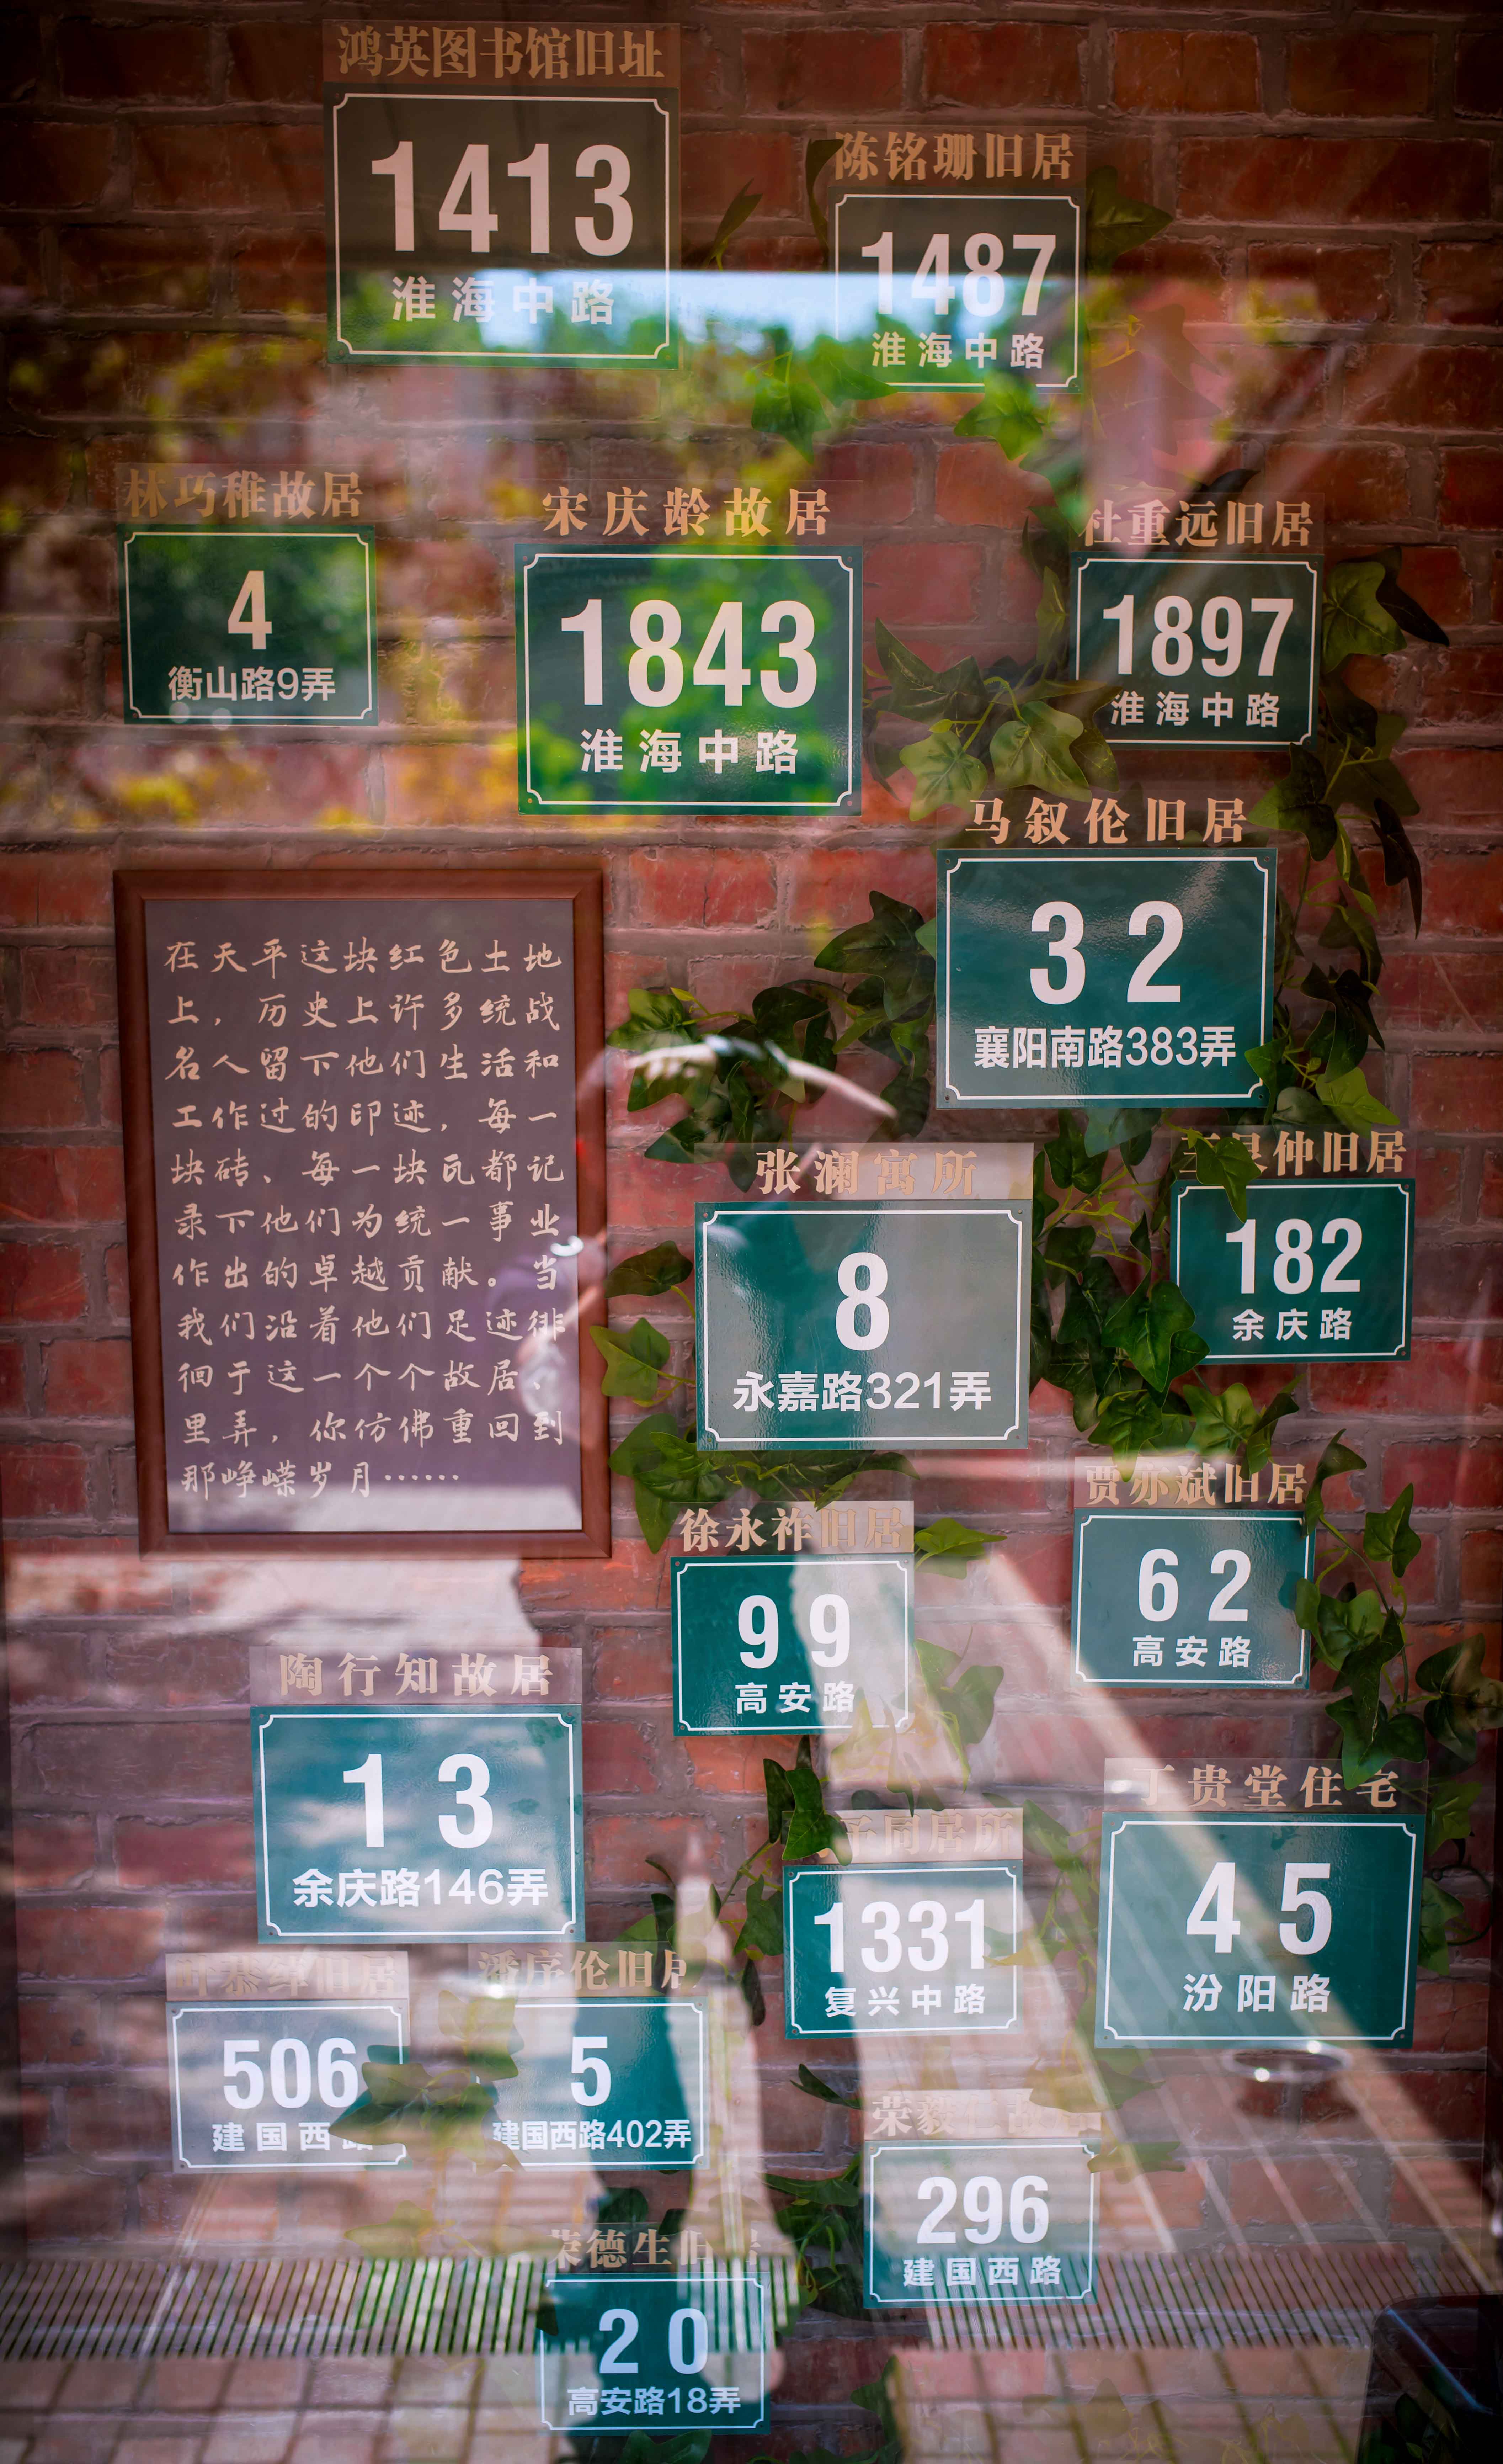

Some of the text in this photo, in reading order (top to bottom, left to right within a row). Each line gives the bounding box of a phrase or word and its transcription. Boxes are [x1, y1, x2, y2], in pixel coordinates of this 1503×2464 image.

[337, 25, 665, 79] 鸿英图书馆旧址
[835, 130, 1074, 181] 陈铭珊旧居
[371, 140, 633, 257] 1413
[861, 231, 1056, 317] 1487
[391, 275, 615, 325] 淮海中路
[871, 331, 1045, 369] 淮海中路
[123, 469, 364, 519] 林巧稚故居
[542, 486, 831, 537] 宋庆龄故居
[228, 570, 272, 650] 4
[561, 599, 818, 708] 1843
[1103, 595, 1294, 678] 1897
[167, 665, 336, 702] 衡山路9弄
[1110, 690, 1280, 727] 淮海中路
[580, 728, 799, 775] 淮海中路
[965, 797, 1247, 845] 马叙伦旧居
[163, 936, 563, 979] 在天平这块红色土地
[167, 991, 561, 1031] 上，历史上许多统战
[165, 1043, 560, 1082] 名人留下他们生活和
[973, 1025, 1236, 1069] 襄阳南路383弄
[172, 1097, 558, 1137] 工作过的印迹，每一
[170, 1148, 565, 1192] 块砖、每一块瓦都记
[756, 1148, 977, 1196] 张澜寓所
[174, 1201, 560, 1243] 录下他们为统一事业
[172, 1254, 559, 1294] 作出的卓越贡献。当
[1226, 1218, 1363, 1295] 182
[835, 1252, 890, 1352] 8
[177, 1306, 566, 1347] 我们沿着他们足迹徘
[1232, 1307, 1352, 1342] 余庆路
[732, 1371, 992, 1412] 永嘉路321弄
[182, 1408, 564, 1449] 里弄，你仿佛重回到
[1084, 1462, 1307, 1506] 贾亦斌旧居
[678, 1506, 904, 1552] 徐永祚旧居
[1132, 1635, 1251, 1668] 高安路
[279, 1652, 554, 1698] 陶行知故居
[734, 1680, 855, 1714] 高安路
[1133, 1764, 1399, 1809] 丁贵堂住宅
[292, 1868, 549, 1908] 余庆路146弄
[814, 1899, 985, 1973] 1331
[825, 1983, 986, 2018] 复兴中路
[1182, 1973, 1331, 2012] 汾阳路
[223, 2037, 359, 2109] 506
[570, 2036, 612, 2107] 5
[492, 2119, 692, 2150] 建国西路402弄
[917, 2175, 1049, 2245] 296
[903, 2256, 1062, 2287] 建国西路
[567, 2386, 741, 2416] 高安路18弄
